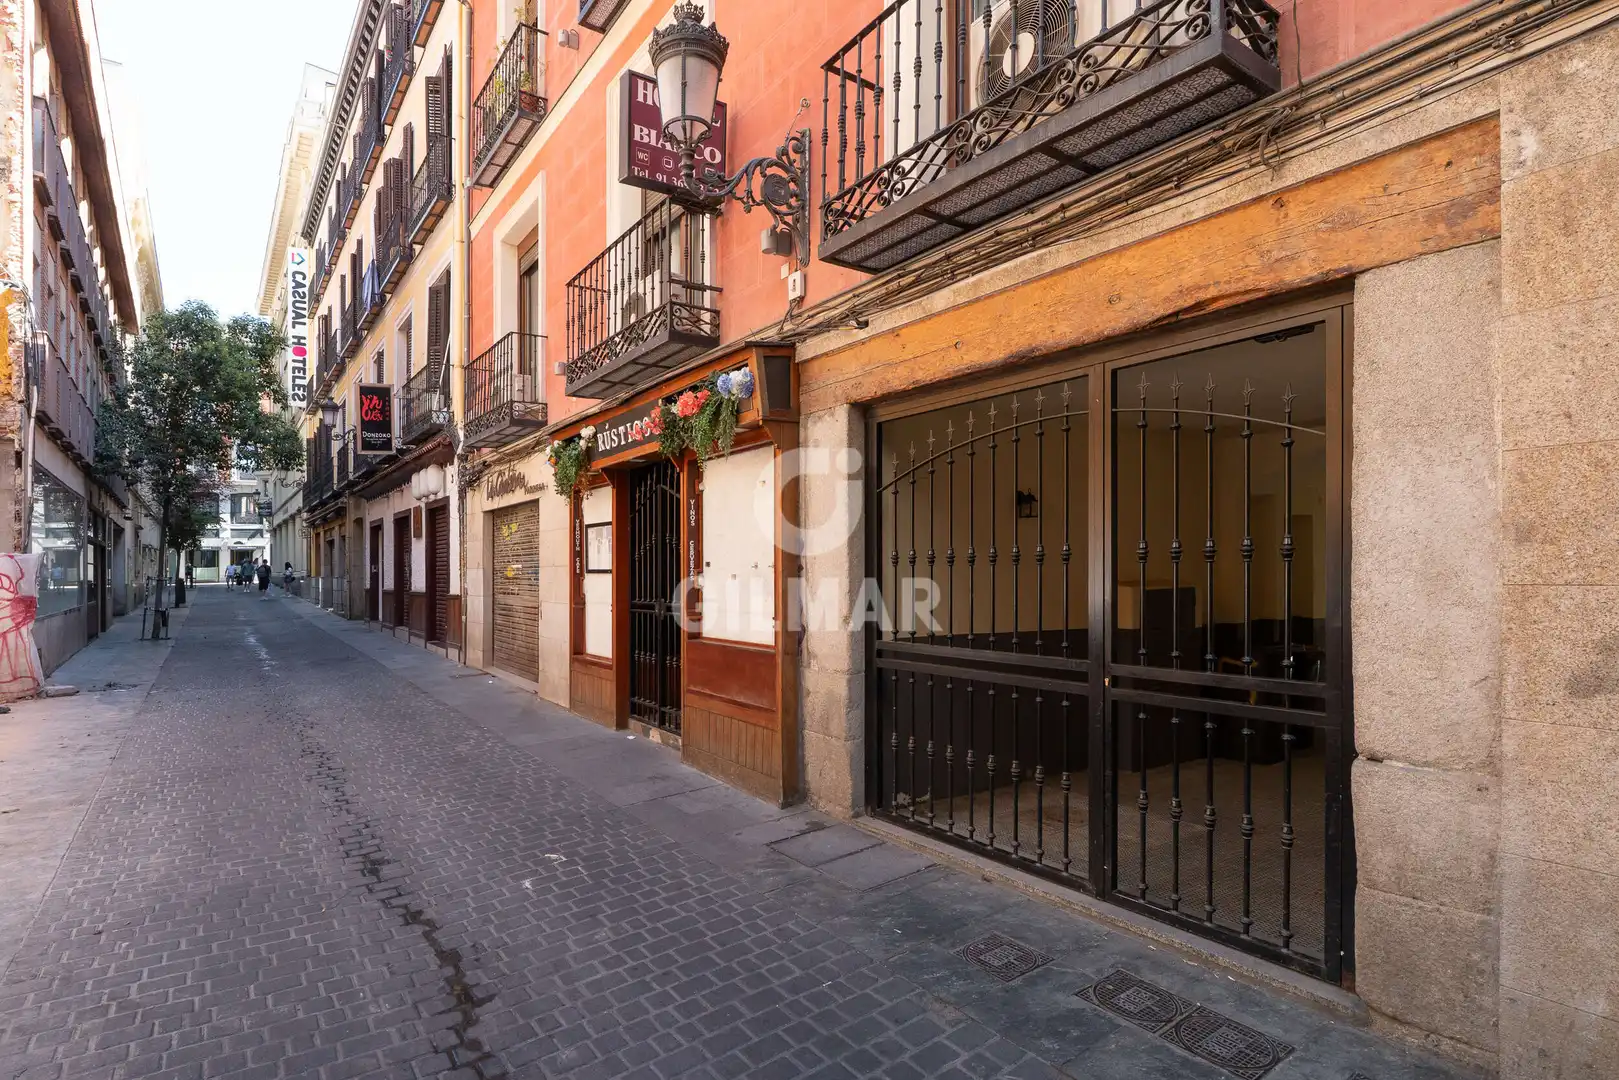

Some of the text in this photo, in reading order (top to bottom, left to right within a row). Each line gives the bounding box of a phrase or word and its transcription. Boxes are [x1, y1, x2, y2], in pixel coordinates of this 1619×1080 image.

[633, 124, 722, 164] BIACO
[637, 151, 649, 161] WC
[291, 270, 307, 402] CASUAL HOTELES
